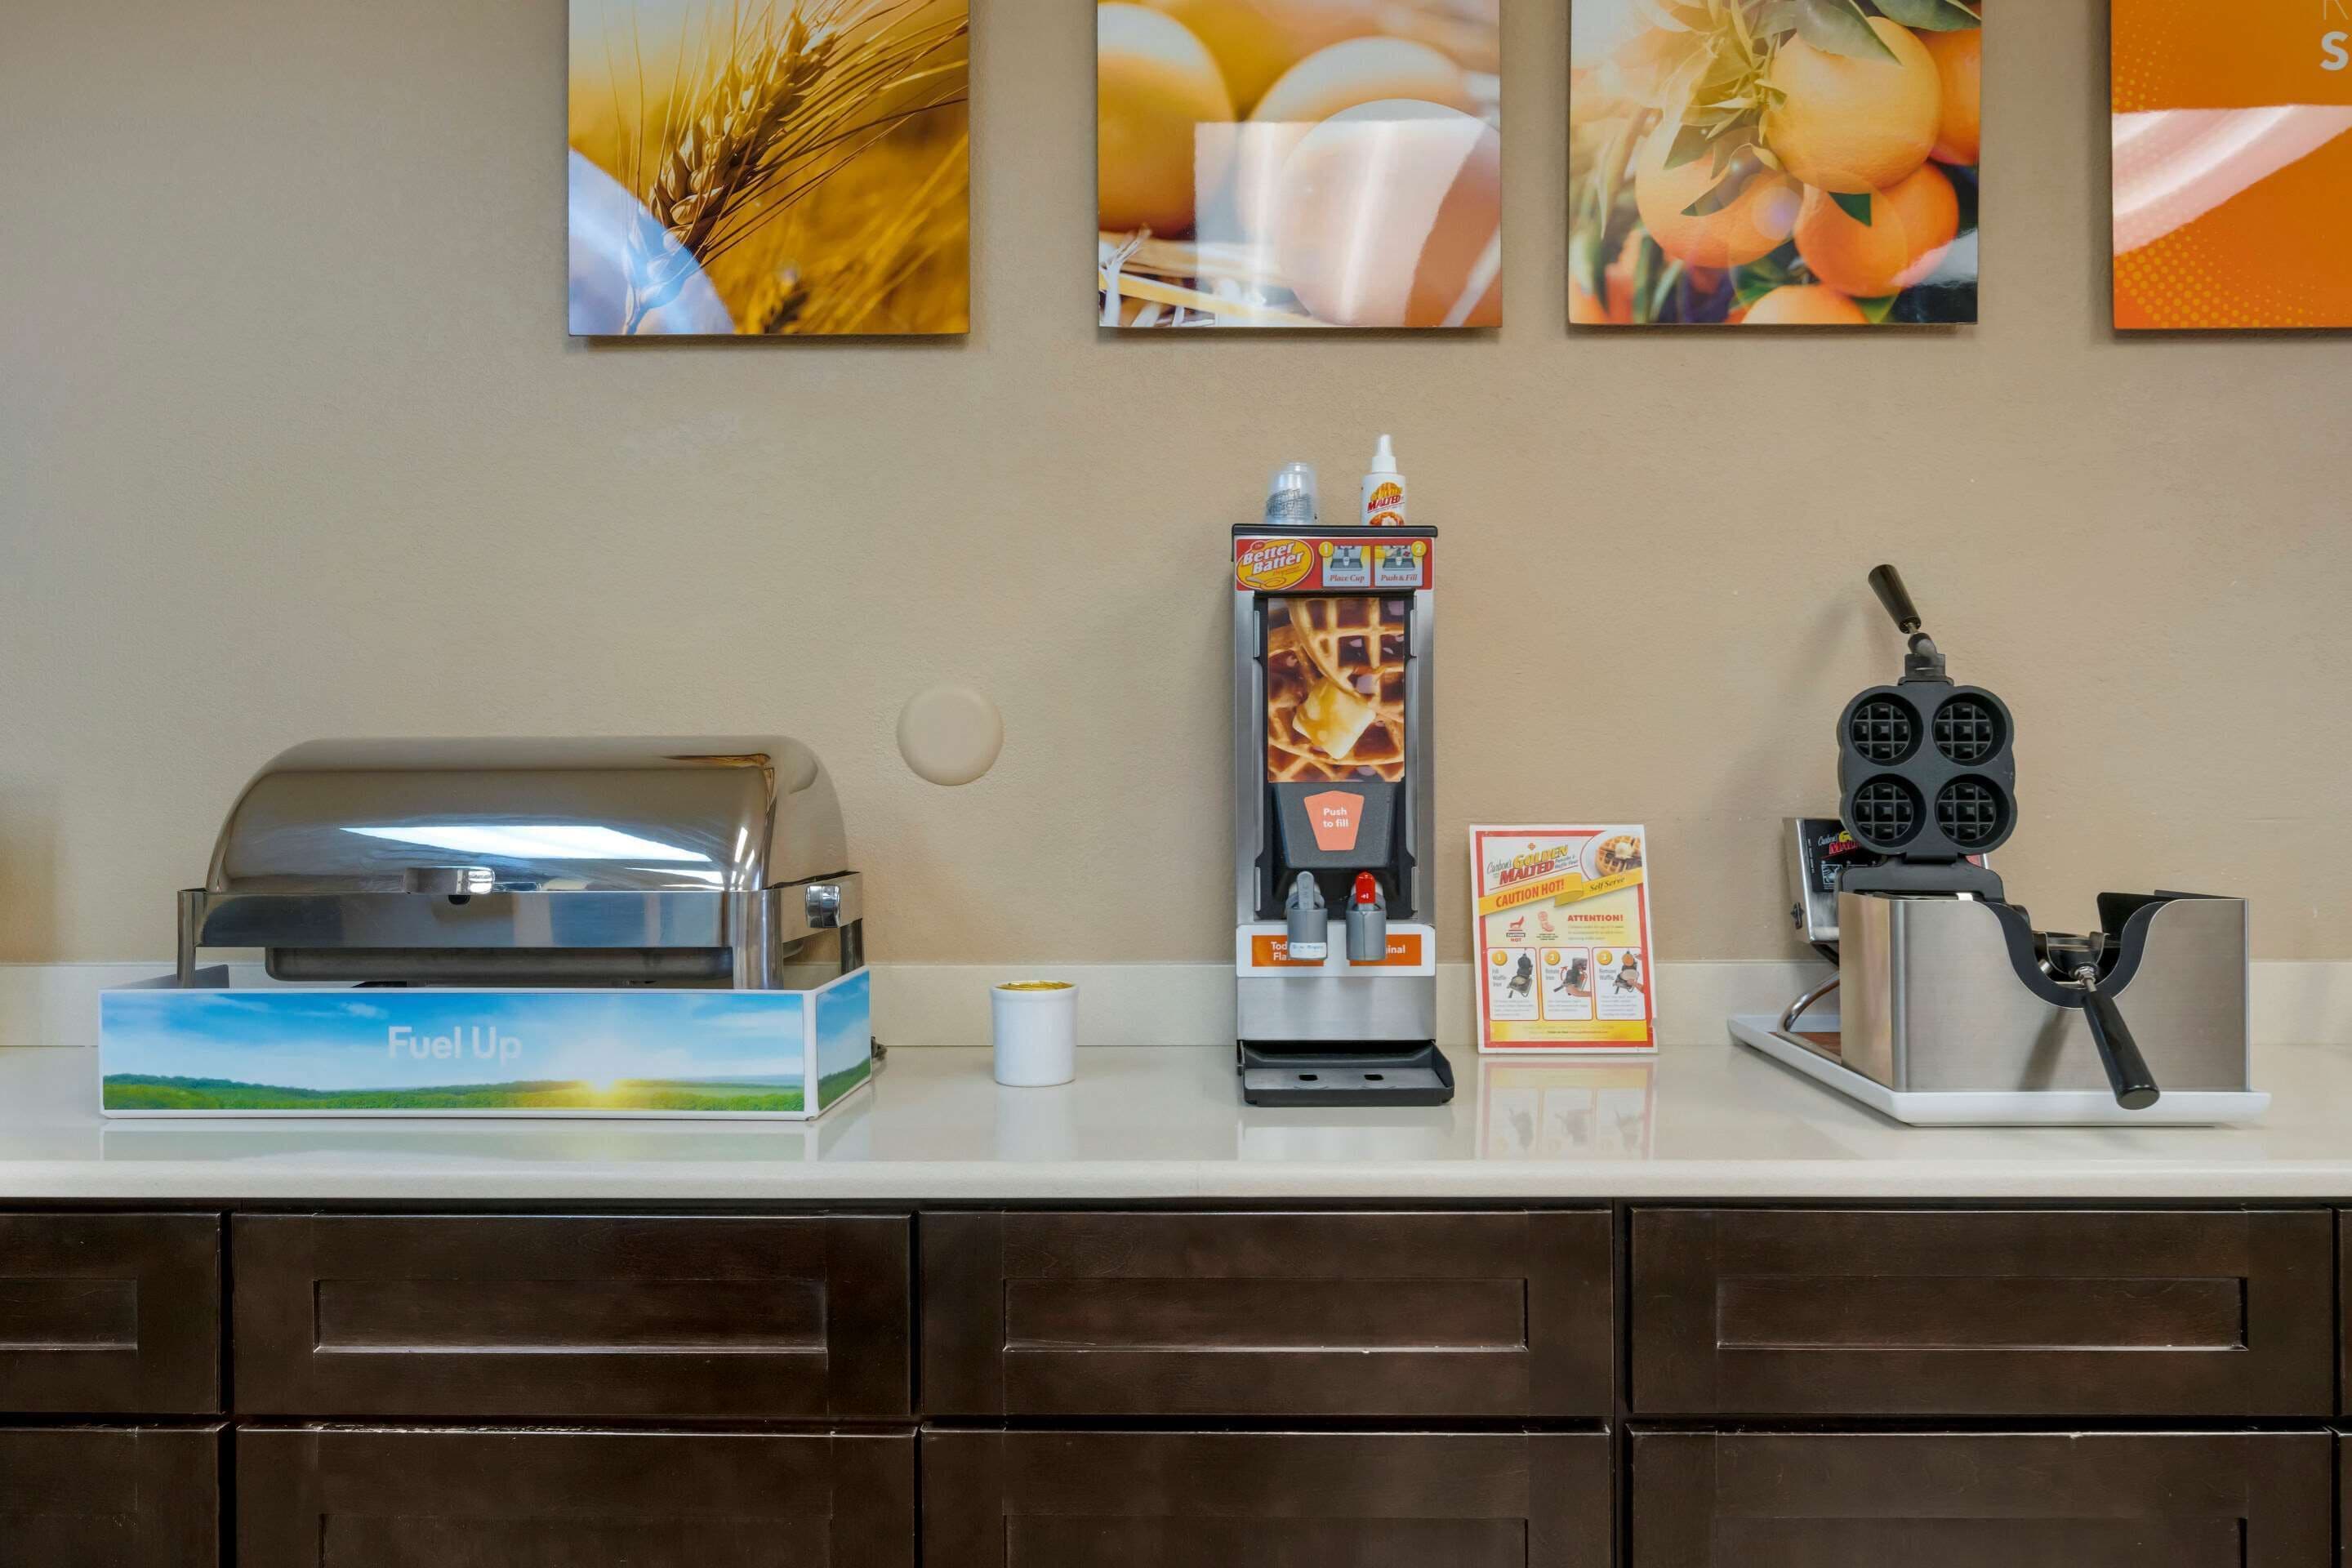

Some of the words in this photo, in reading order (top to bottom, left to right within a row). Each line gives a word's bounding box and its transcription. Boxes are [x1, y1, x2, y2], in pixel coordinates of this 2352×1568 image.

[1243, 541, 1295, 565] Better
[1253, 552, 1304, 574] Batter
[1350, 574, 1365, 583] Cup
[1405, 573, 1418, 581] Fill
[1323, 808, 1348, 816] Push
[1323, 819, 1334, 827] to
[1335, 818, 1349, 827] fill
[1499, 860, 1555, 885] MALTED
[1590, 882, 1604, 890] Self
[1605, 876, 1625, 886] Serve
[1496, 885, 1539, 907] CAUTION
[1541, 879, 1565, 896] HOT!
[1567, 914, 1624, 922] ATTENTION!
[388, 1026, 461, 1059] Fuel
[471, 1026, 523, 1067] Up
